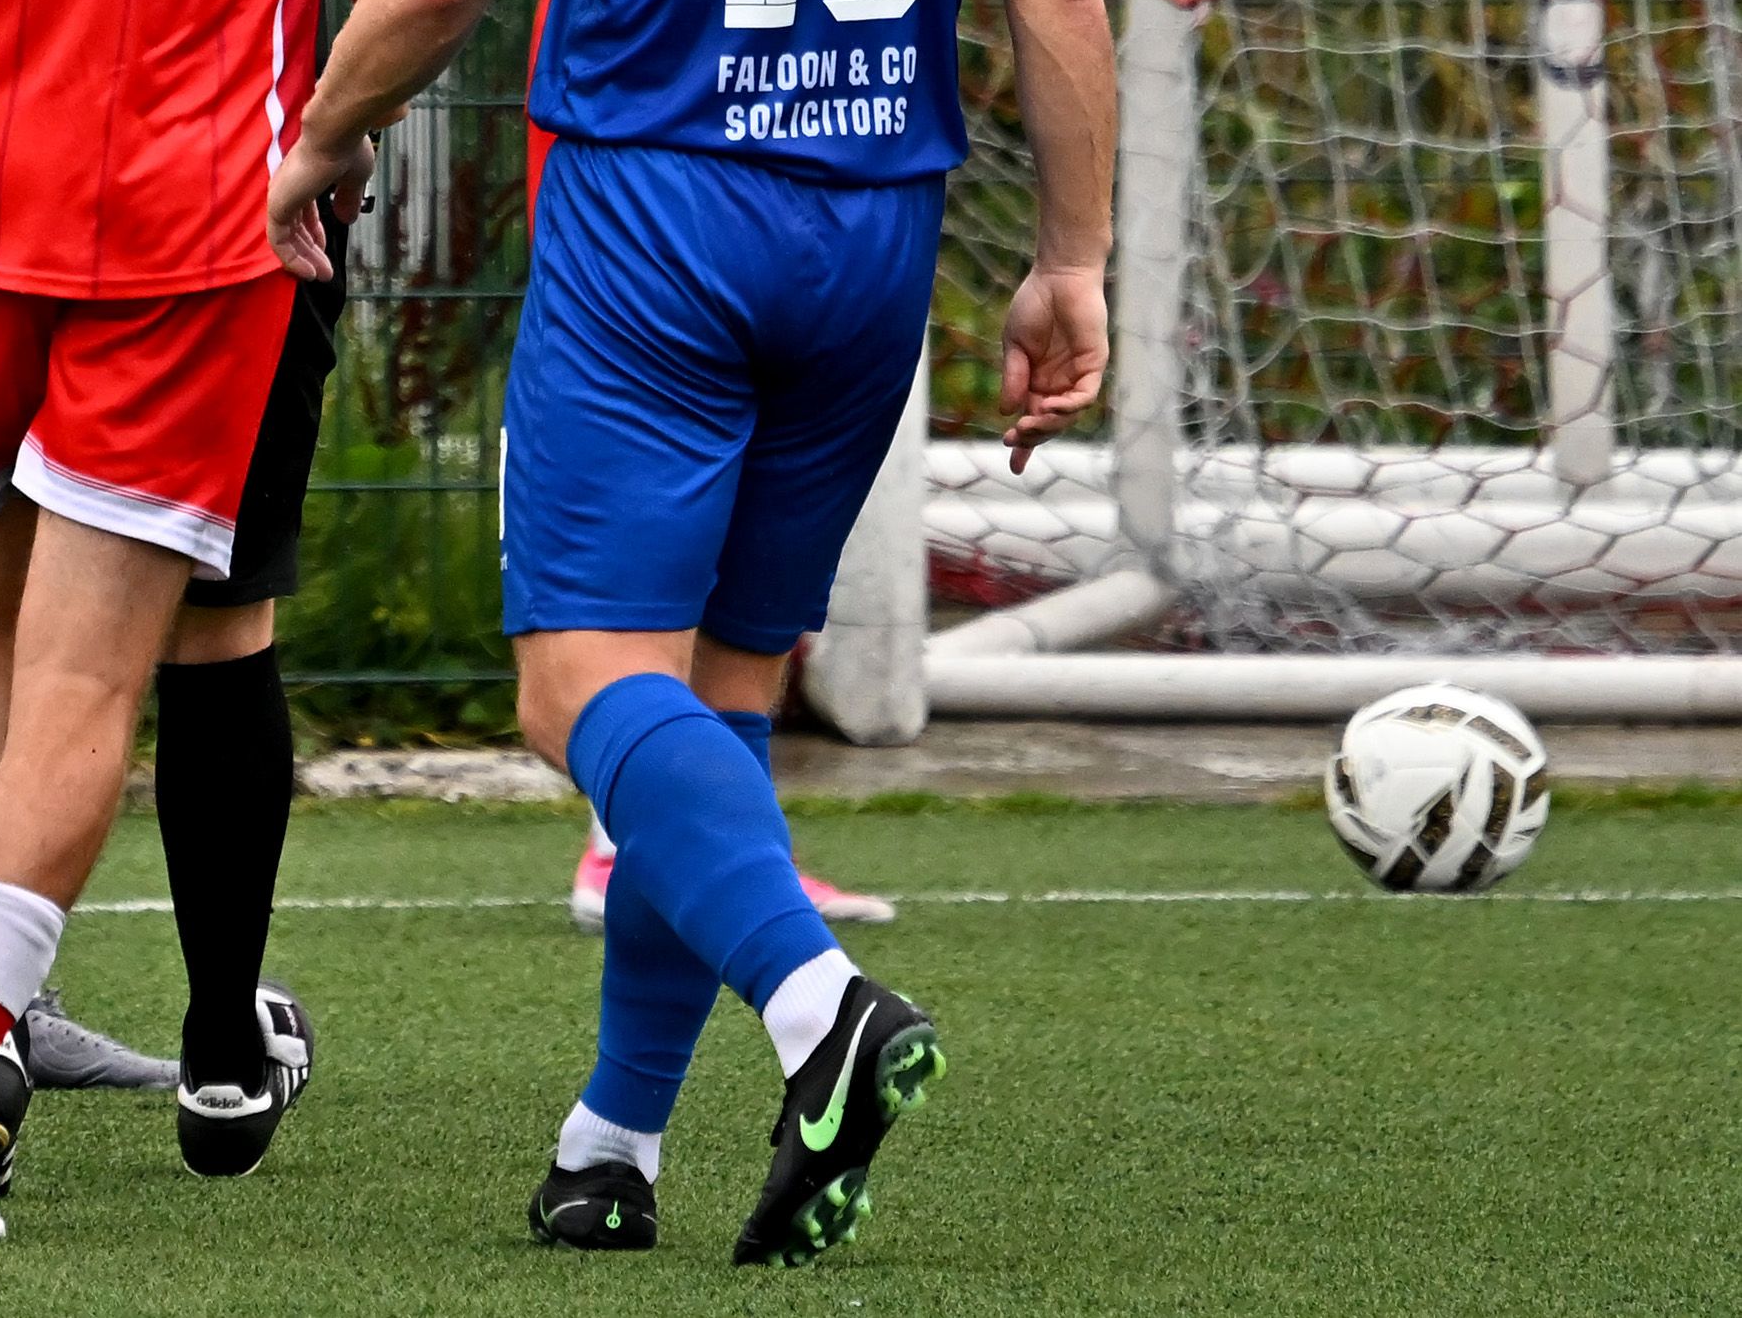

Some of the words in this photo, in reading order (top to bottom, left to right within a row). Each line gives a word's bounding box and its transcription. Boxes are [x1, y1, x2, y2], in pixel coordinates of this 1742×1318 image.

[717, 50, 837, 93] FALOON
[848, 49, 870, 86] &
[881, 46, 917, 85] CO
[724, 96, 907, 141] SOLICITORS
